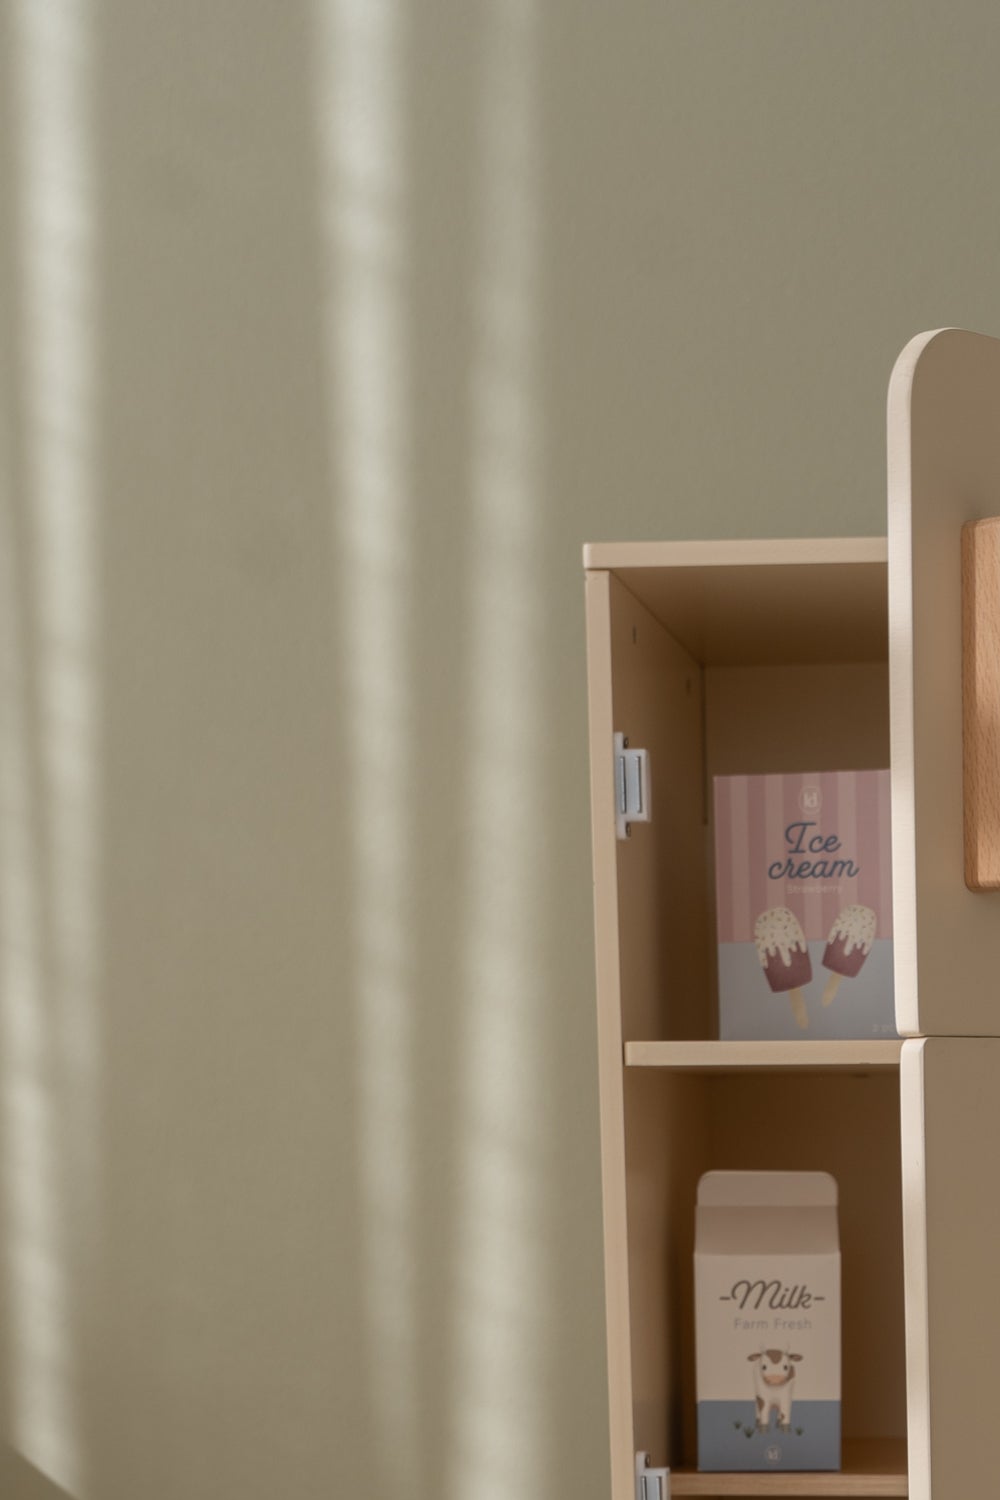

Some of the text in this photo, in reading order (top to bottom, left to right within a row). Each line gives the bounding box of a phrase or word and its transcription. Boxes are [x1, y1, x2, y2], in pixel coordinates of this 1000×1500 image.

[784, 822, 842, 854] Ice
[768, 857, 860, 880] cream
[733, 1317, 812, 1331] Farm Fresh
